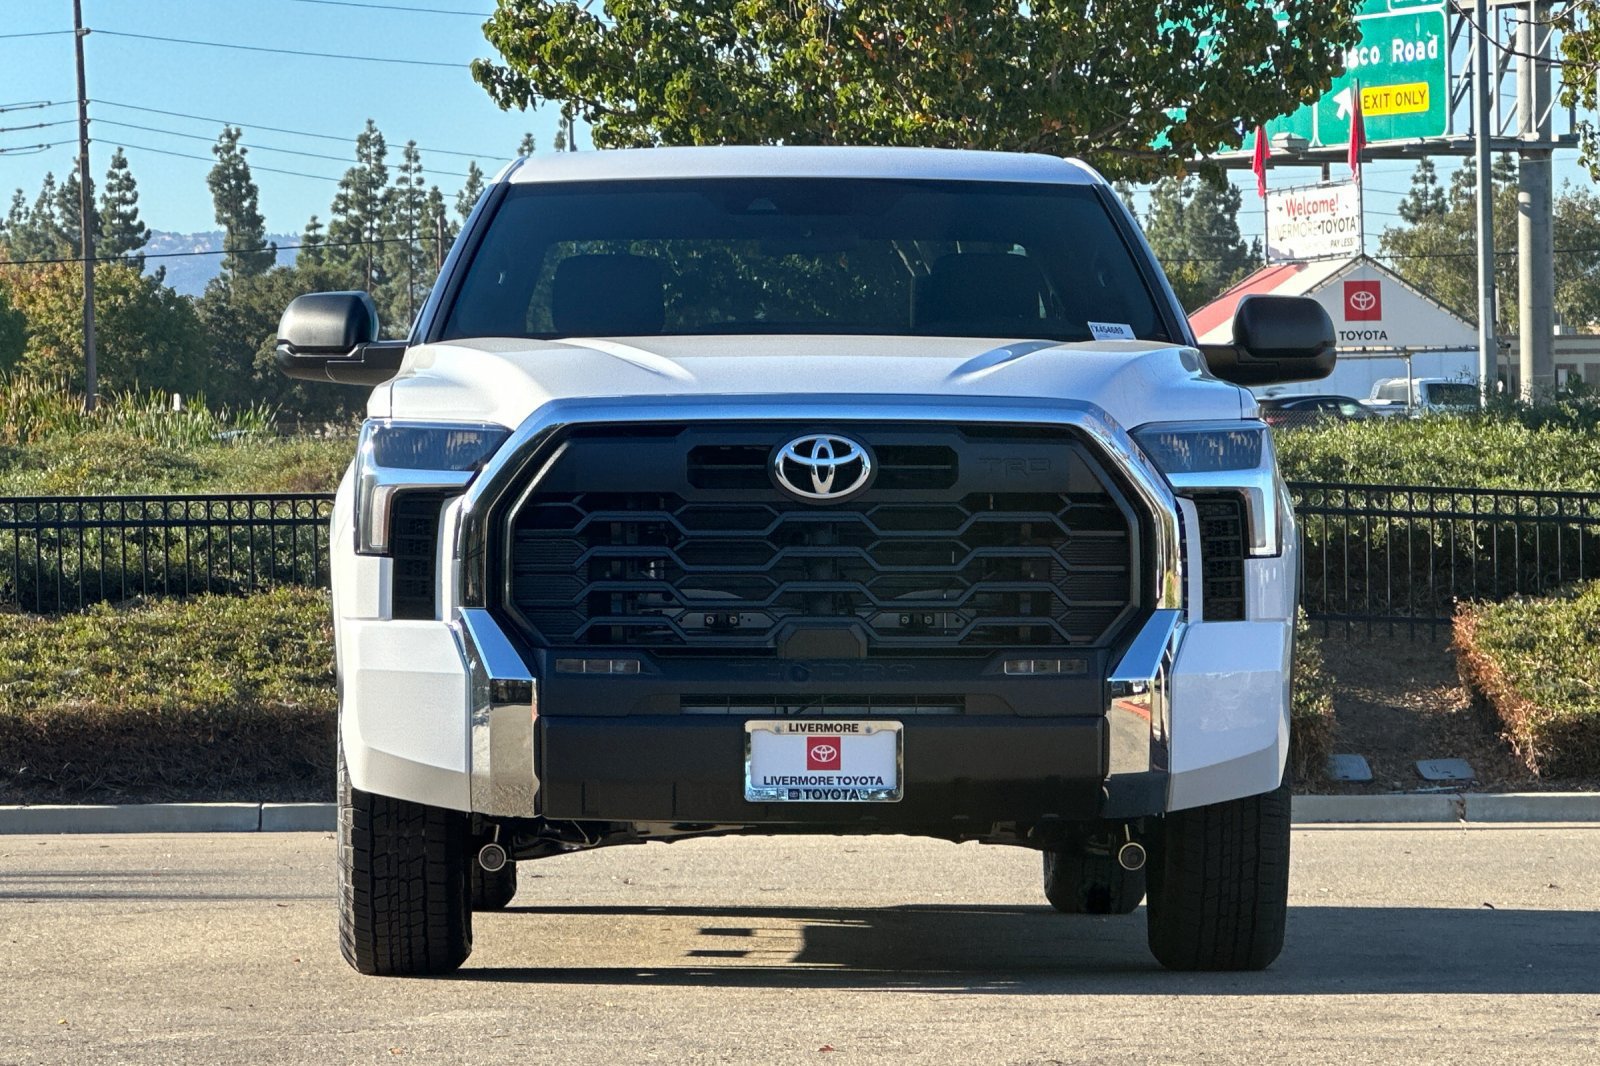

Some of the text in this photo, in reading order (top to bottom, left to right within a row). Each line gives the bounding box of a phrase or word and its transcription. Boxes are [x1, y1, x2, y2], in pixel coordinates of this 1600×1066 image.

[1392, 34, 1438, 63] Road
[1363, 89, 1426, 109] EXIT ONLY
[1286, 193, 1339, 217] Welcome!
[1320, 216, 1356, 235] TOYOTA
[1339, 330, 1388, 341] TOYOTA
[788, 723, 859, 733] LIVERMORE
[763, 776, 884, 786] LIVERMORE TOYOTA
[803, 788, 859, 801] TOYOTA
